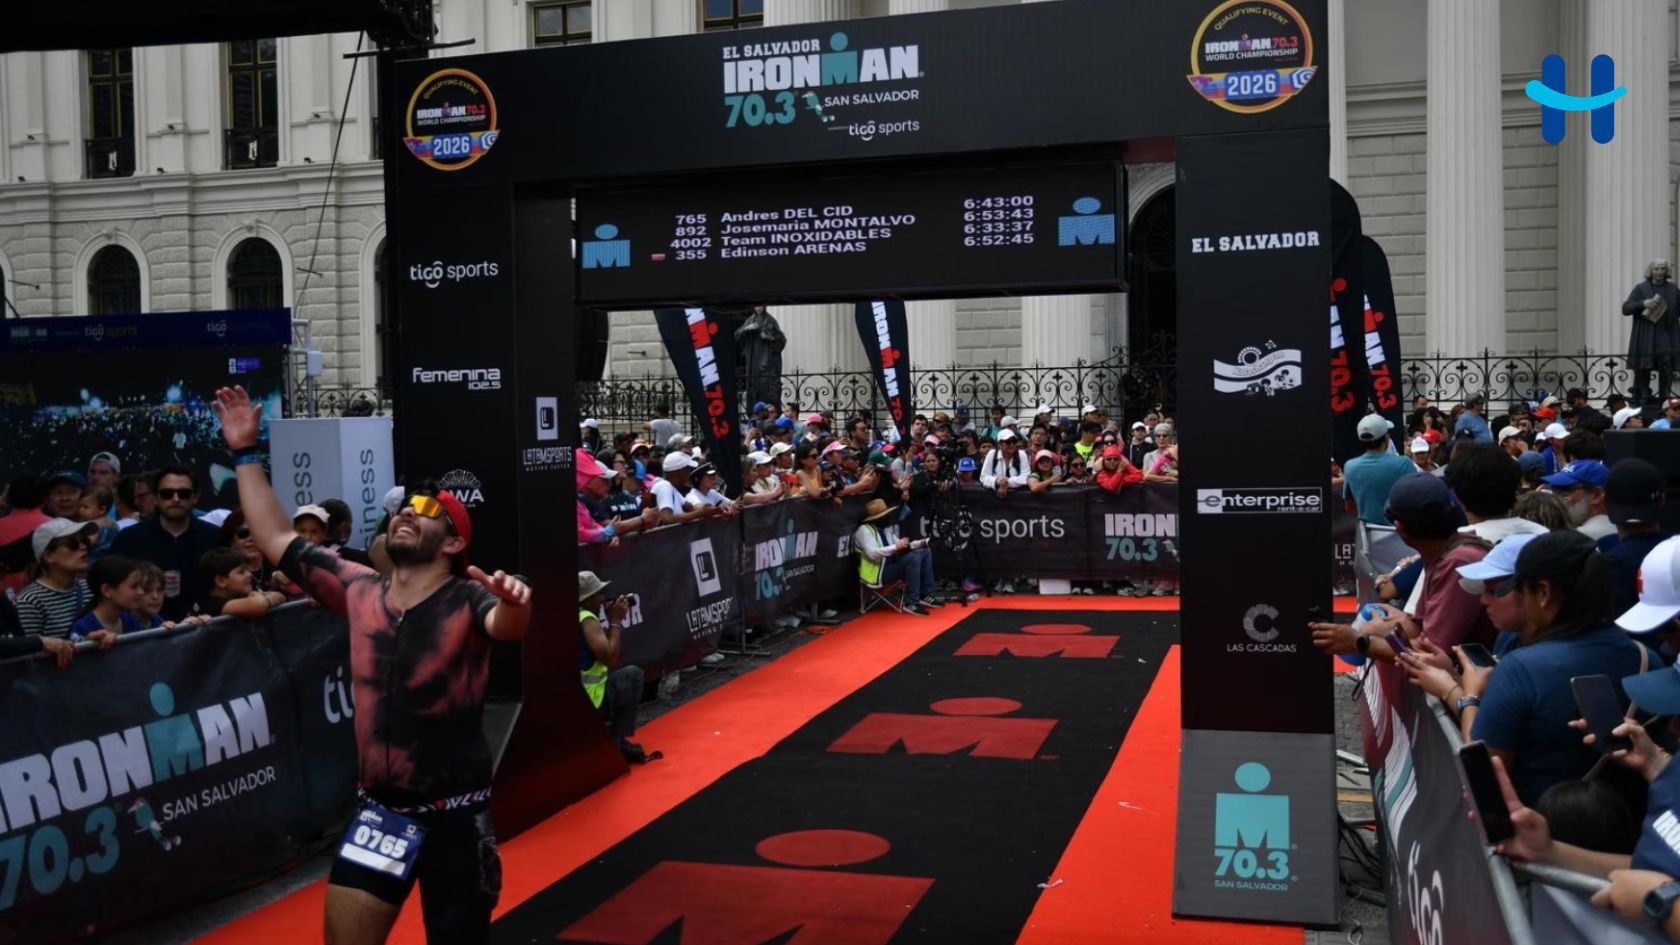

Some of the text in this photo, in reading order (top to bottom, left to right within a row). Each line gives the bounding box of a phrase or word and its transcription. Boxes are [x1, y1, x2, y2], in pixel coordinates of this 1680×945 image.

[1214, 7, 1289, 31] QUALIFYING EVENT
[722, 39, 820, 59] EL SALVADOR
[1205, 33, 1298, 53] IRONMAN 70.3
[1205, 52, 1234, 62] WORLD
[1236, 47, 1298, 60] CHAMPIONSHIP
[723, 32, 919, 94] IRONMAN
[1227, 73, 1276, 96] 2026
[417, 118, 439, 126] WORLD
[440, 114, 486, 125] CHAMPIONSHIP
[725, 89, 919, 128] 70.3 SAN SALVADOR
[878, 120, 920, 135] sports
[433, 136, 470, 156] 2026
[675, 195, 1034, 225] 765 Andres DEL CID 6:43:00
[675, 208, 1034, 237] 892 Josemaria MONTALVO 6:53:43
[670, 221, 1034, 249] 4002 Team INOXIDABLES 6:33:37
[675, 233, 1034, 261] 355 Edinson ARENAS 6:52:45
[1192, 231, 1320, 253] EL SALVADOR
[447, 261, 499, 282] sports
[871, 301, 902, 399] IRONMAN
[468, 382, 501, 390] 102.5
[1330, 350, 1355, 413] 70.3
[1370, 363, 1397, 410] 70.3
[704, 384, 730, 439] 70.3
[523, 446, 572, 465] LATAMSPORTS
[1204, 492, 1320, 510] enterprise
[980, 515, 1065, 544] sports
[1104, 513, 1179, 537] IRON
[1105, 537, 1158, 562] 70.3
[1226, 643, 1297, 653] LAS CASCADAS
[324, 665, 356, 723] ti
[162, 765, 276, 822] SAN SALVADOR
[354, 825, 408, 859] 0765
[0, 805, 120, 911] 70.3
[1214, 849, 1289, 880] 70.3
[1214, 879, 1288, 891] SAN SALVADOR
